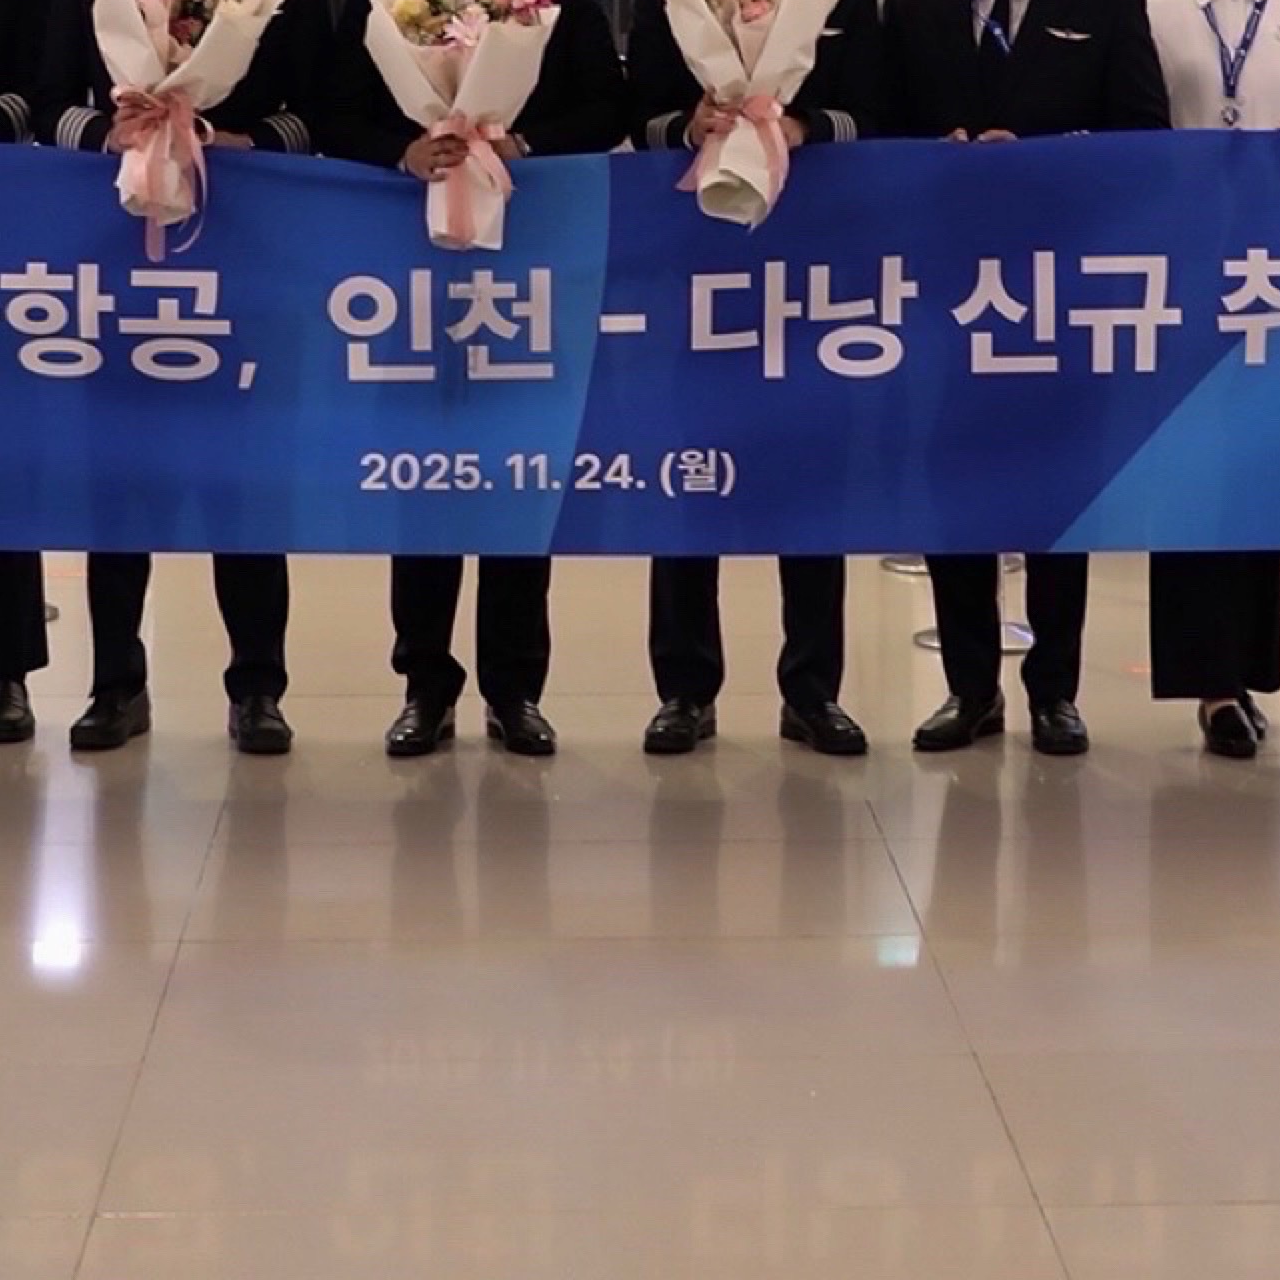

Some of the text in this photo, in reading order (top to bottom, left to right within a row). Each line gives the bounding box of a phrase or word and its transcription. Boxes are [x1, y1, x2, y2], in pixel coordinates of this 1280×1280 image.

[329, 269, 553, 380] 인천
[692, 257, 917, 377] 다낭
[953, 252, 1181, 372] 신규
[361, 450, 734, 496] 2025. 11. 24. (월)
